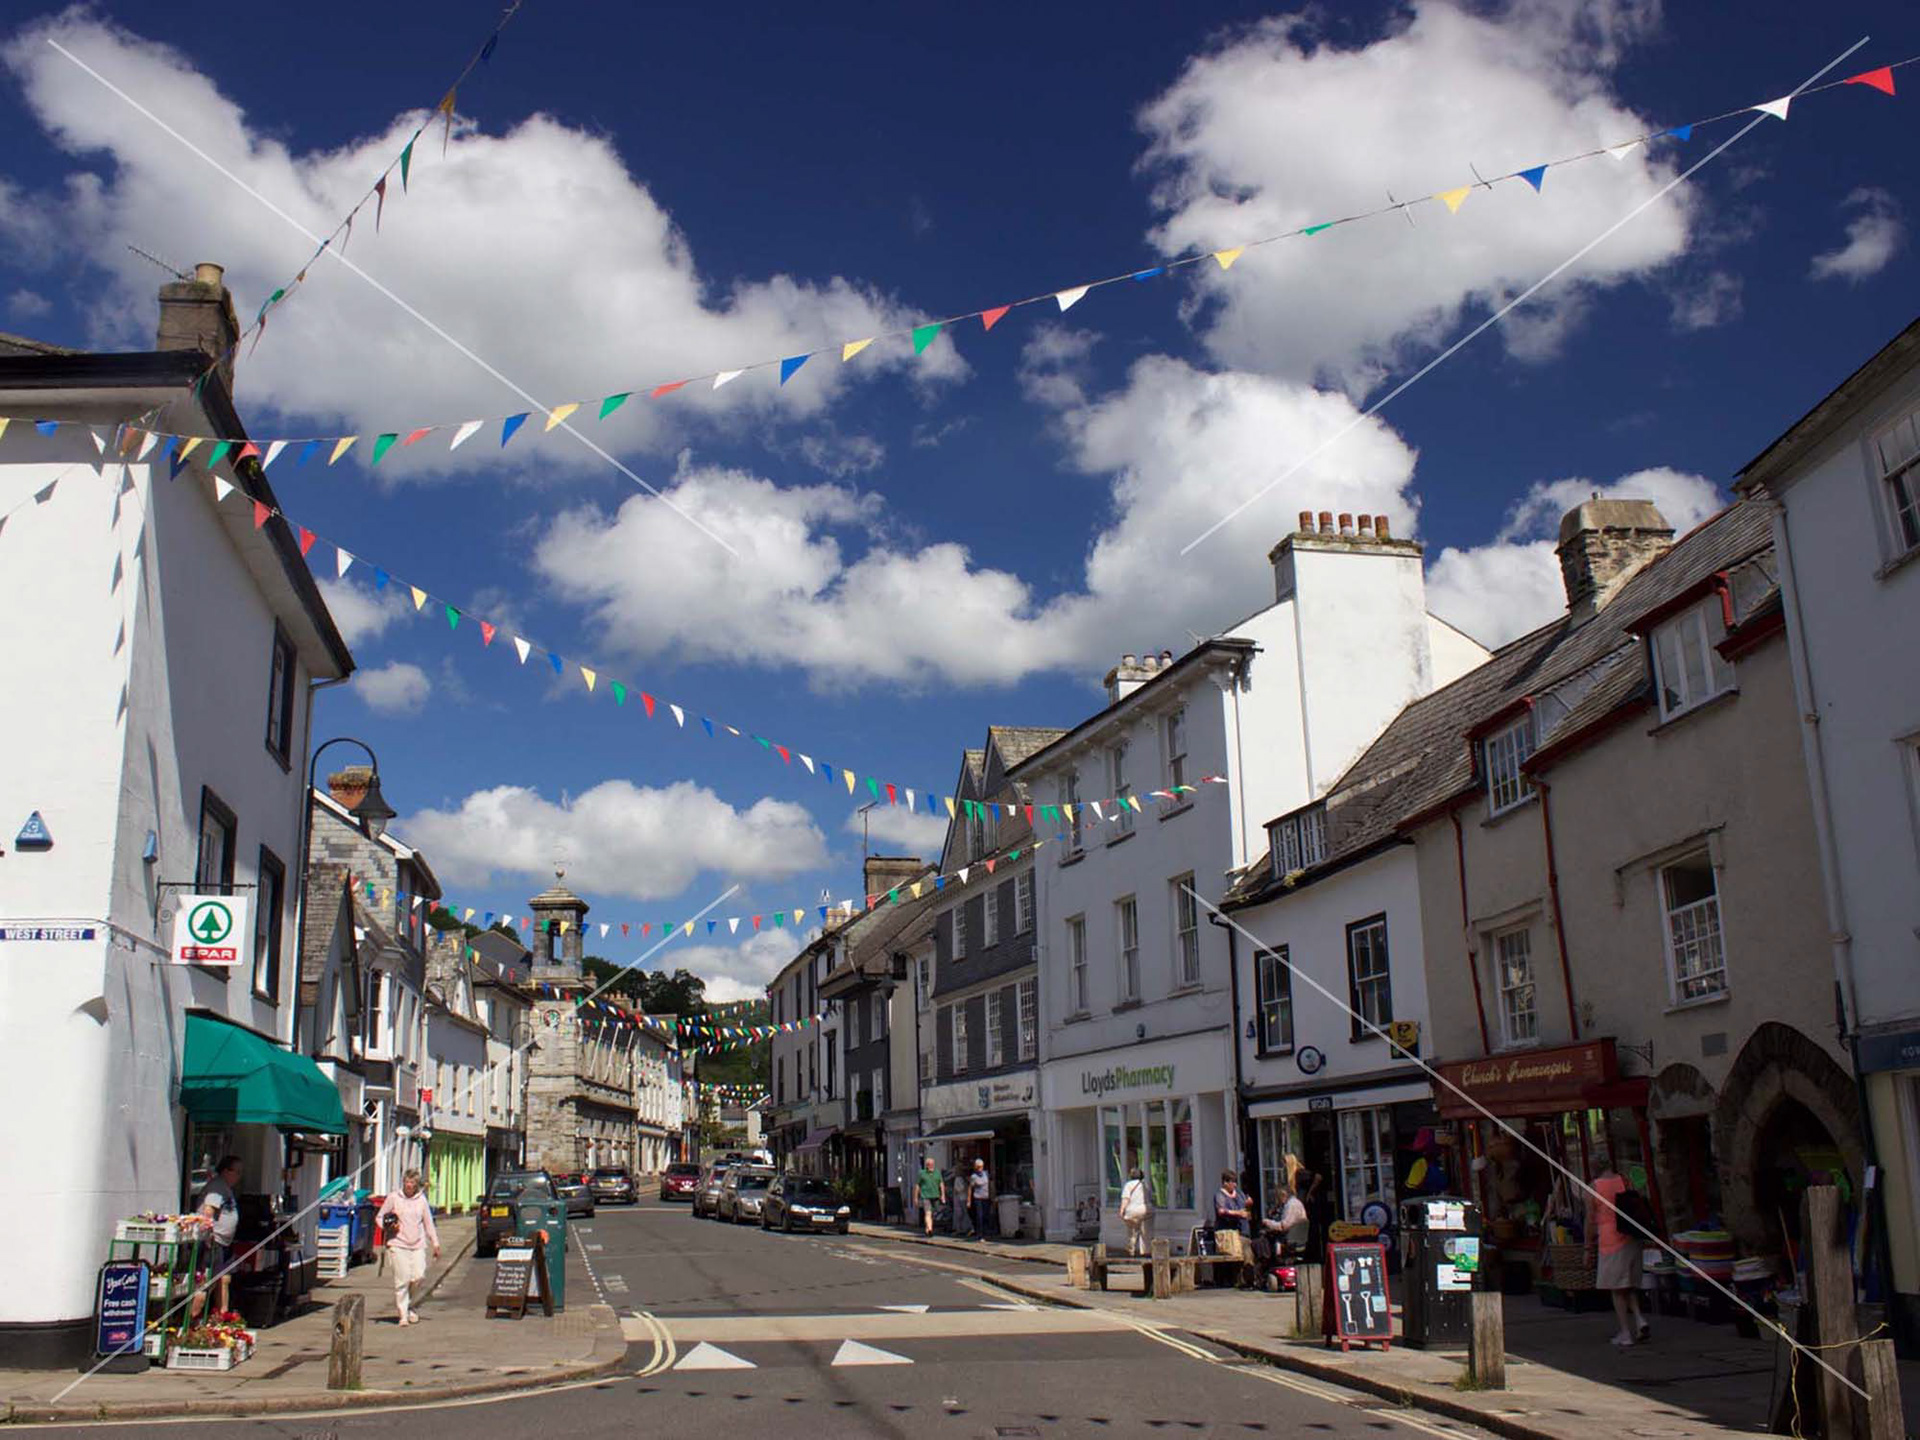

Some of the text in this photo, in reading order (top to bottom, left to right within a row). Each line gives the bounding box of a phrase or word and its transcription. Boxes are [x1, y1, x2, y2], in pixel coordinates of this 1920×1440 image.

[4, 928, 84, 940] WEST STREET
[184, 949, 232, 959] SPAR
[1081, 1064, 1175, 1098] LloydsPharmacy
[104, 1299, 136, 1307] Free cash
